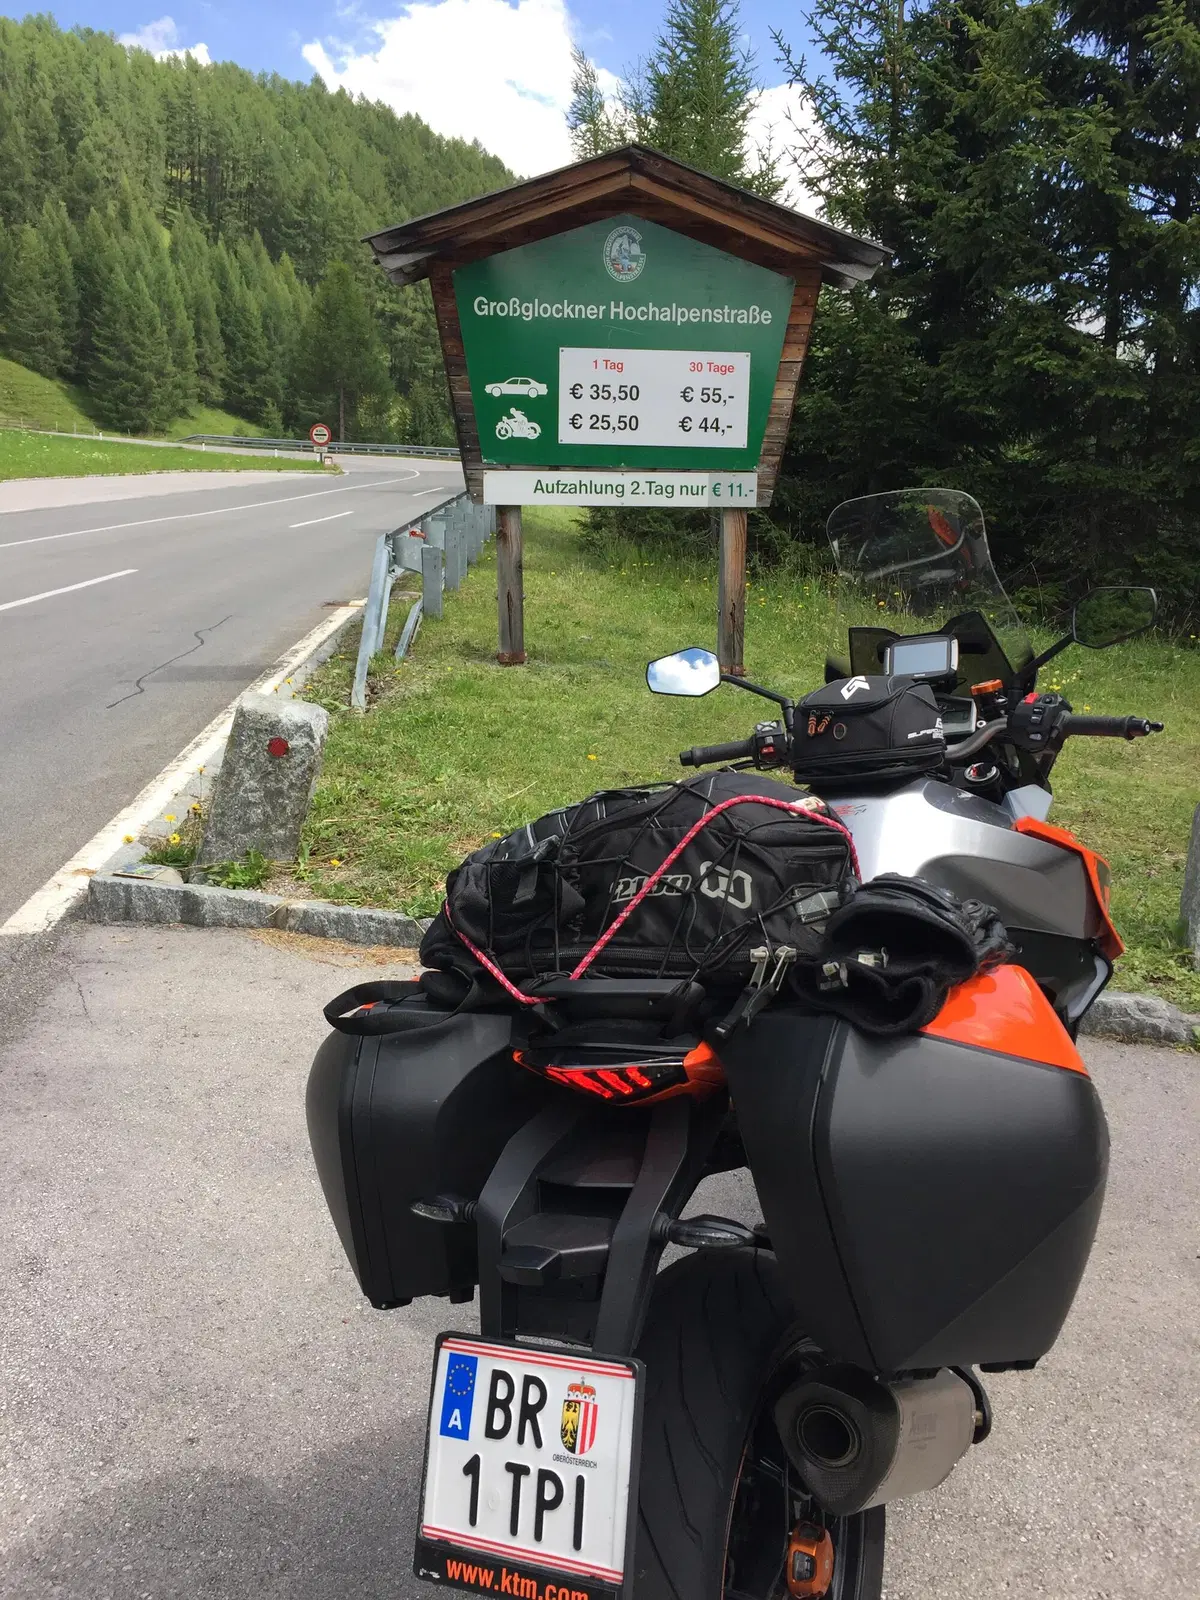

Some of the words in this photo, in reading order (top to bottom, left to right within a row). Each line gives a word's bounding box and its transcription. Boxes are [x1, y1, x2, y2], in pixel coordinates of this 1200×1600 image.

[473, 296, 606, 321] Großglockner
[610, 301, 772, 325] Hochalpenstraße
[593, 360, 598, 370] 1
[603, 359, 624, 373] Tag
[689, 361, 703, 373] 30
[706, 362, 735, 376] Tage
[569, 383, 583, 400] €
[589, 384, 640, 404] 35,50
[680, 386, 694, 403] €
[700, 387, 735, 407] 55,-
[568, 413, 583, 430] €
[589, 414, 639, 434] 25,50
[678, 416, 692, 433] €
[698, 417, 733, 437] 44,-
[533, 479, 625, 498] Aufzahlung
[630, 480, 675, 499] 2.Tag
[679, 484, 707, 496] nur
[712, 482, 722, 497] €
[728, 483, 754, 497] 11.-
[448, 1408, 462, 1430] A
[484, 1368, 548, 1449] BR
[552, 1453, 598, 1469] OBERÖSTERREICH
[462, 1453, 481, 1527] 1
[504, 1461, 585, 1551] TPI
